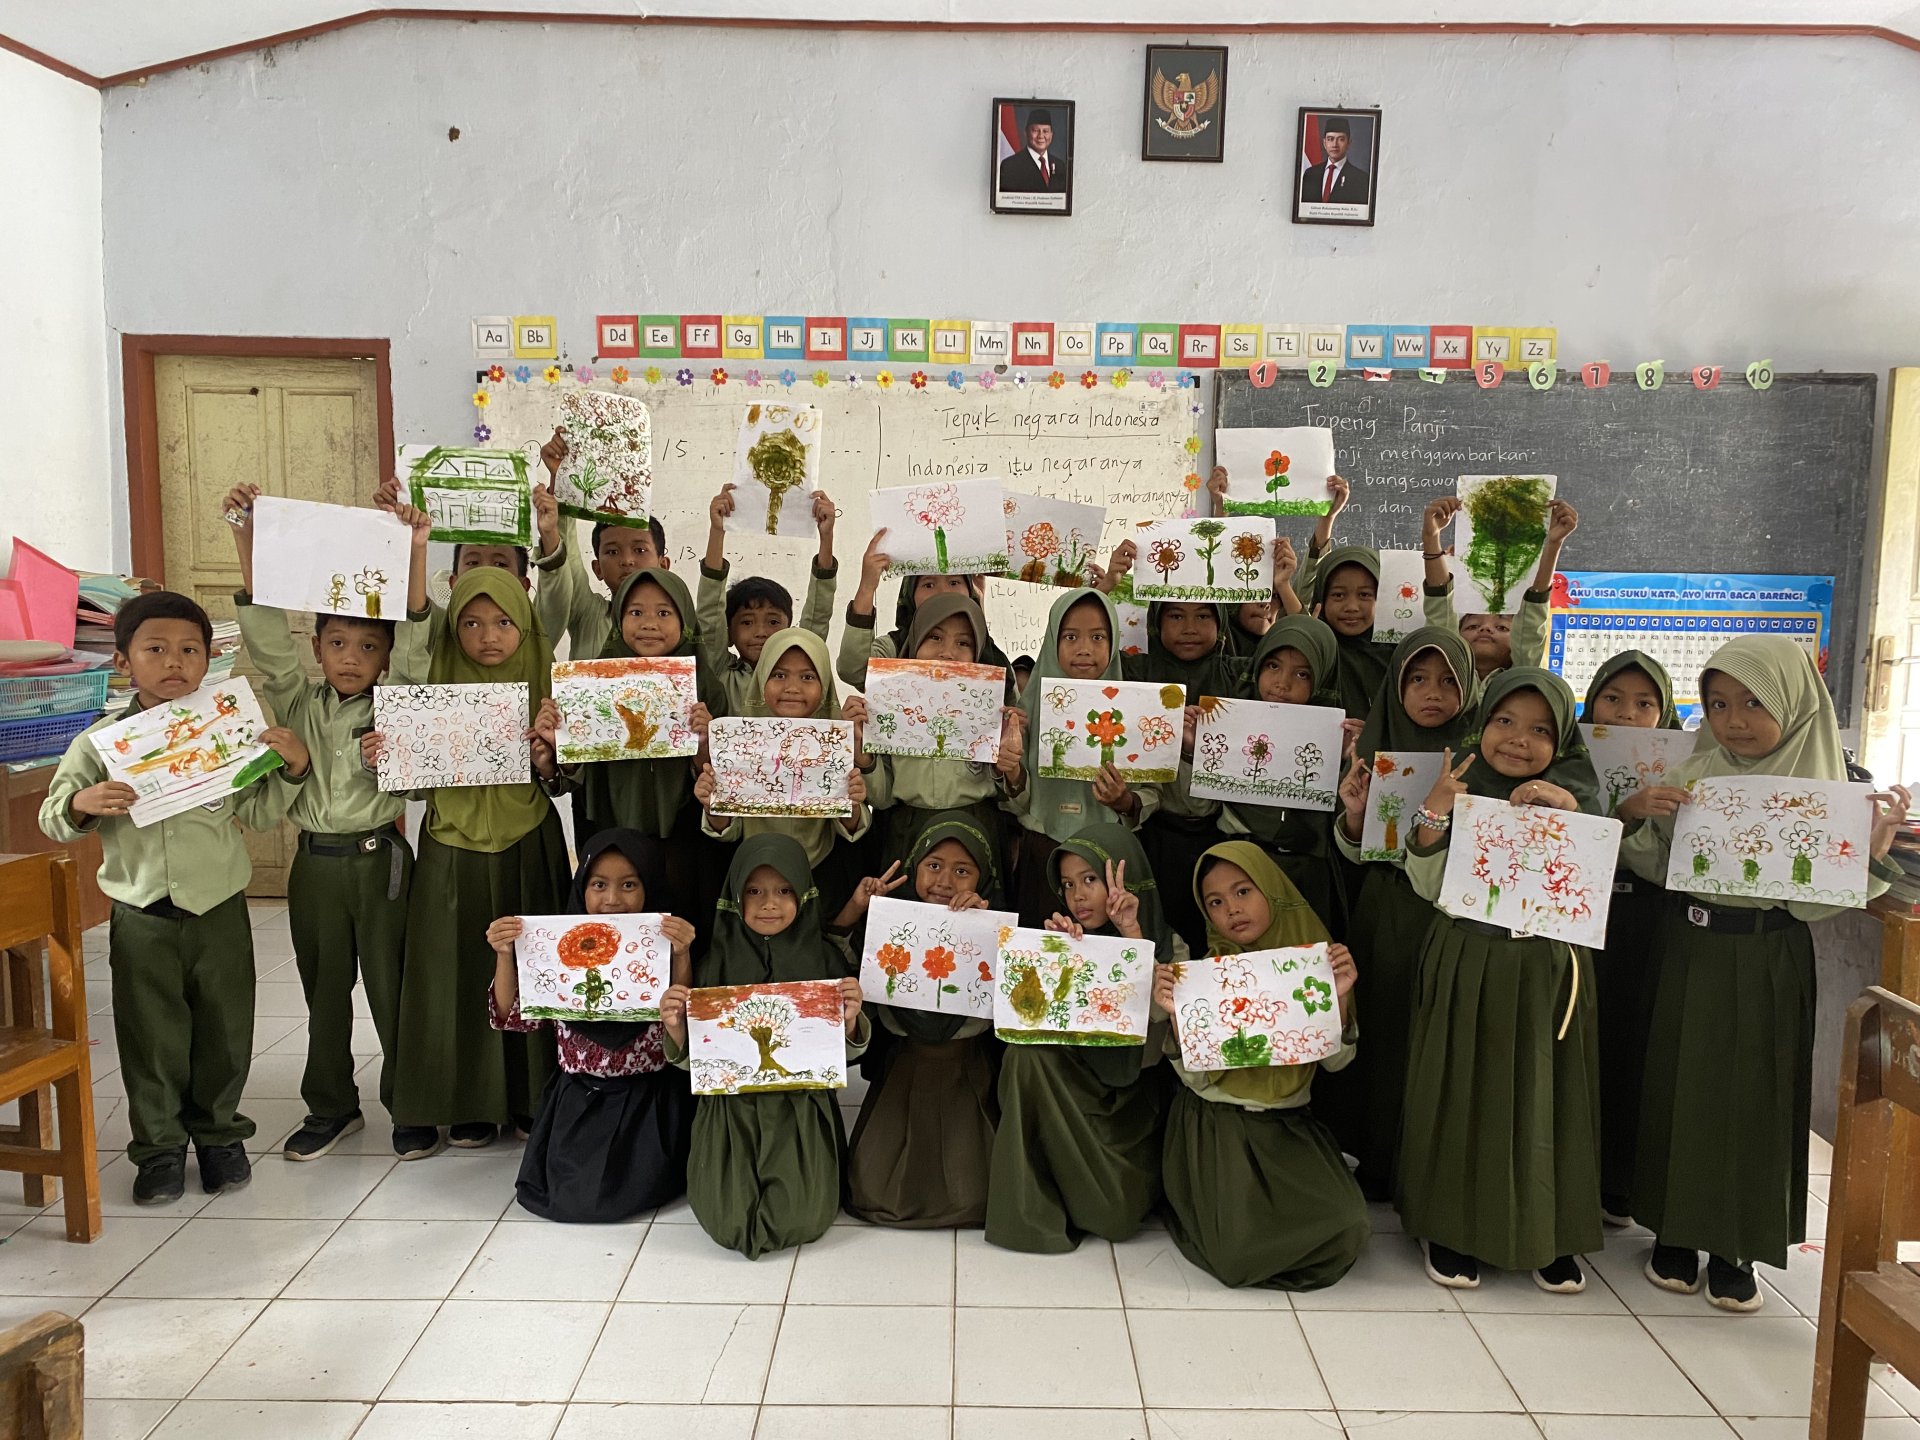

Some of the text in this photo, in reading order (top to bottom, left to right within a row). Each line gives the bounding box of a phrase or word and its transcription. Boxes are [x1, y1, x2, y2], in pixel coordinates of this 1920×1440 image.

[485, 328, 1544, 356] Aa Bb Dd Ee Ff Gg Hh Ii Jj Kk Ll Mm Nn Oo Pp Qq Rr Ss Tt Uu Vv Ww Xx Yy Zz
[1255, 364, 1268, 383] 1
[1315, 365, 1327, 383] 2
[1483, 365, 1495, 384] 5
[1536, 367, 1548, 385] 6
[1590, 367, 1600, 385] 7
[1644, 367, 1655, 387] 8
[1699, 367, 1712, 386] 9
[1749, 367, 1771, 384] 10
[941, 404, 1160, 440] Tepuk negara Indonesia
[1301, 403, 1445, 441] Topeng Panji
[1334, 445, 1529, 467] nji menggambarkan
[907, 454, 1142, 483] Indonesia itu negaranya
[1365, 469, 1457, 492] bangsawa
[1379, 500, 1412, 514] dan
[1569, 589, 1803, 600] AKU BISA SUKU KATA, AYO KITA BACA BARENG!
